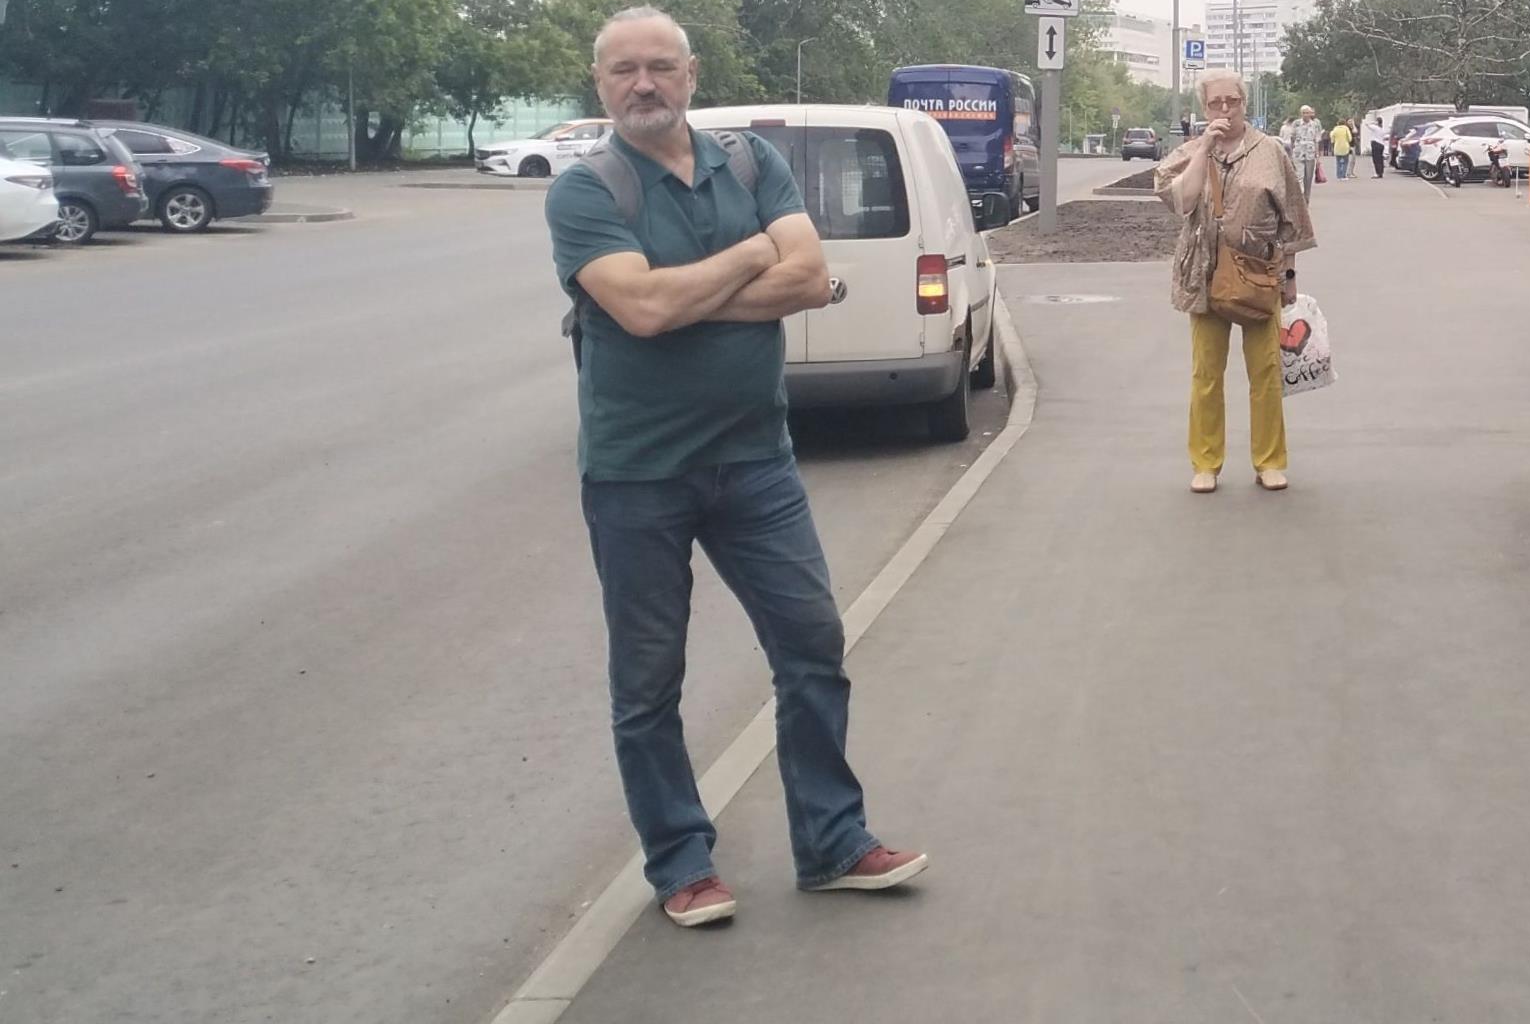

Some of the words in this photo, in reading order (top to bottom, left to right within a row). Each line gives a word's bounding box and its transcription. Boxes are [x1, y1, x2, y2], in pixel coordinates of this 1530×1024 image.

[1190, 41, 1202, 57] P
[903, 98, 944, 111] ПОЧТА
[948, 98, 997, 112] РОССИИ
